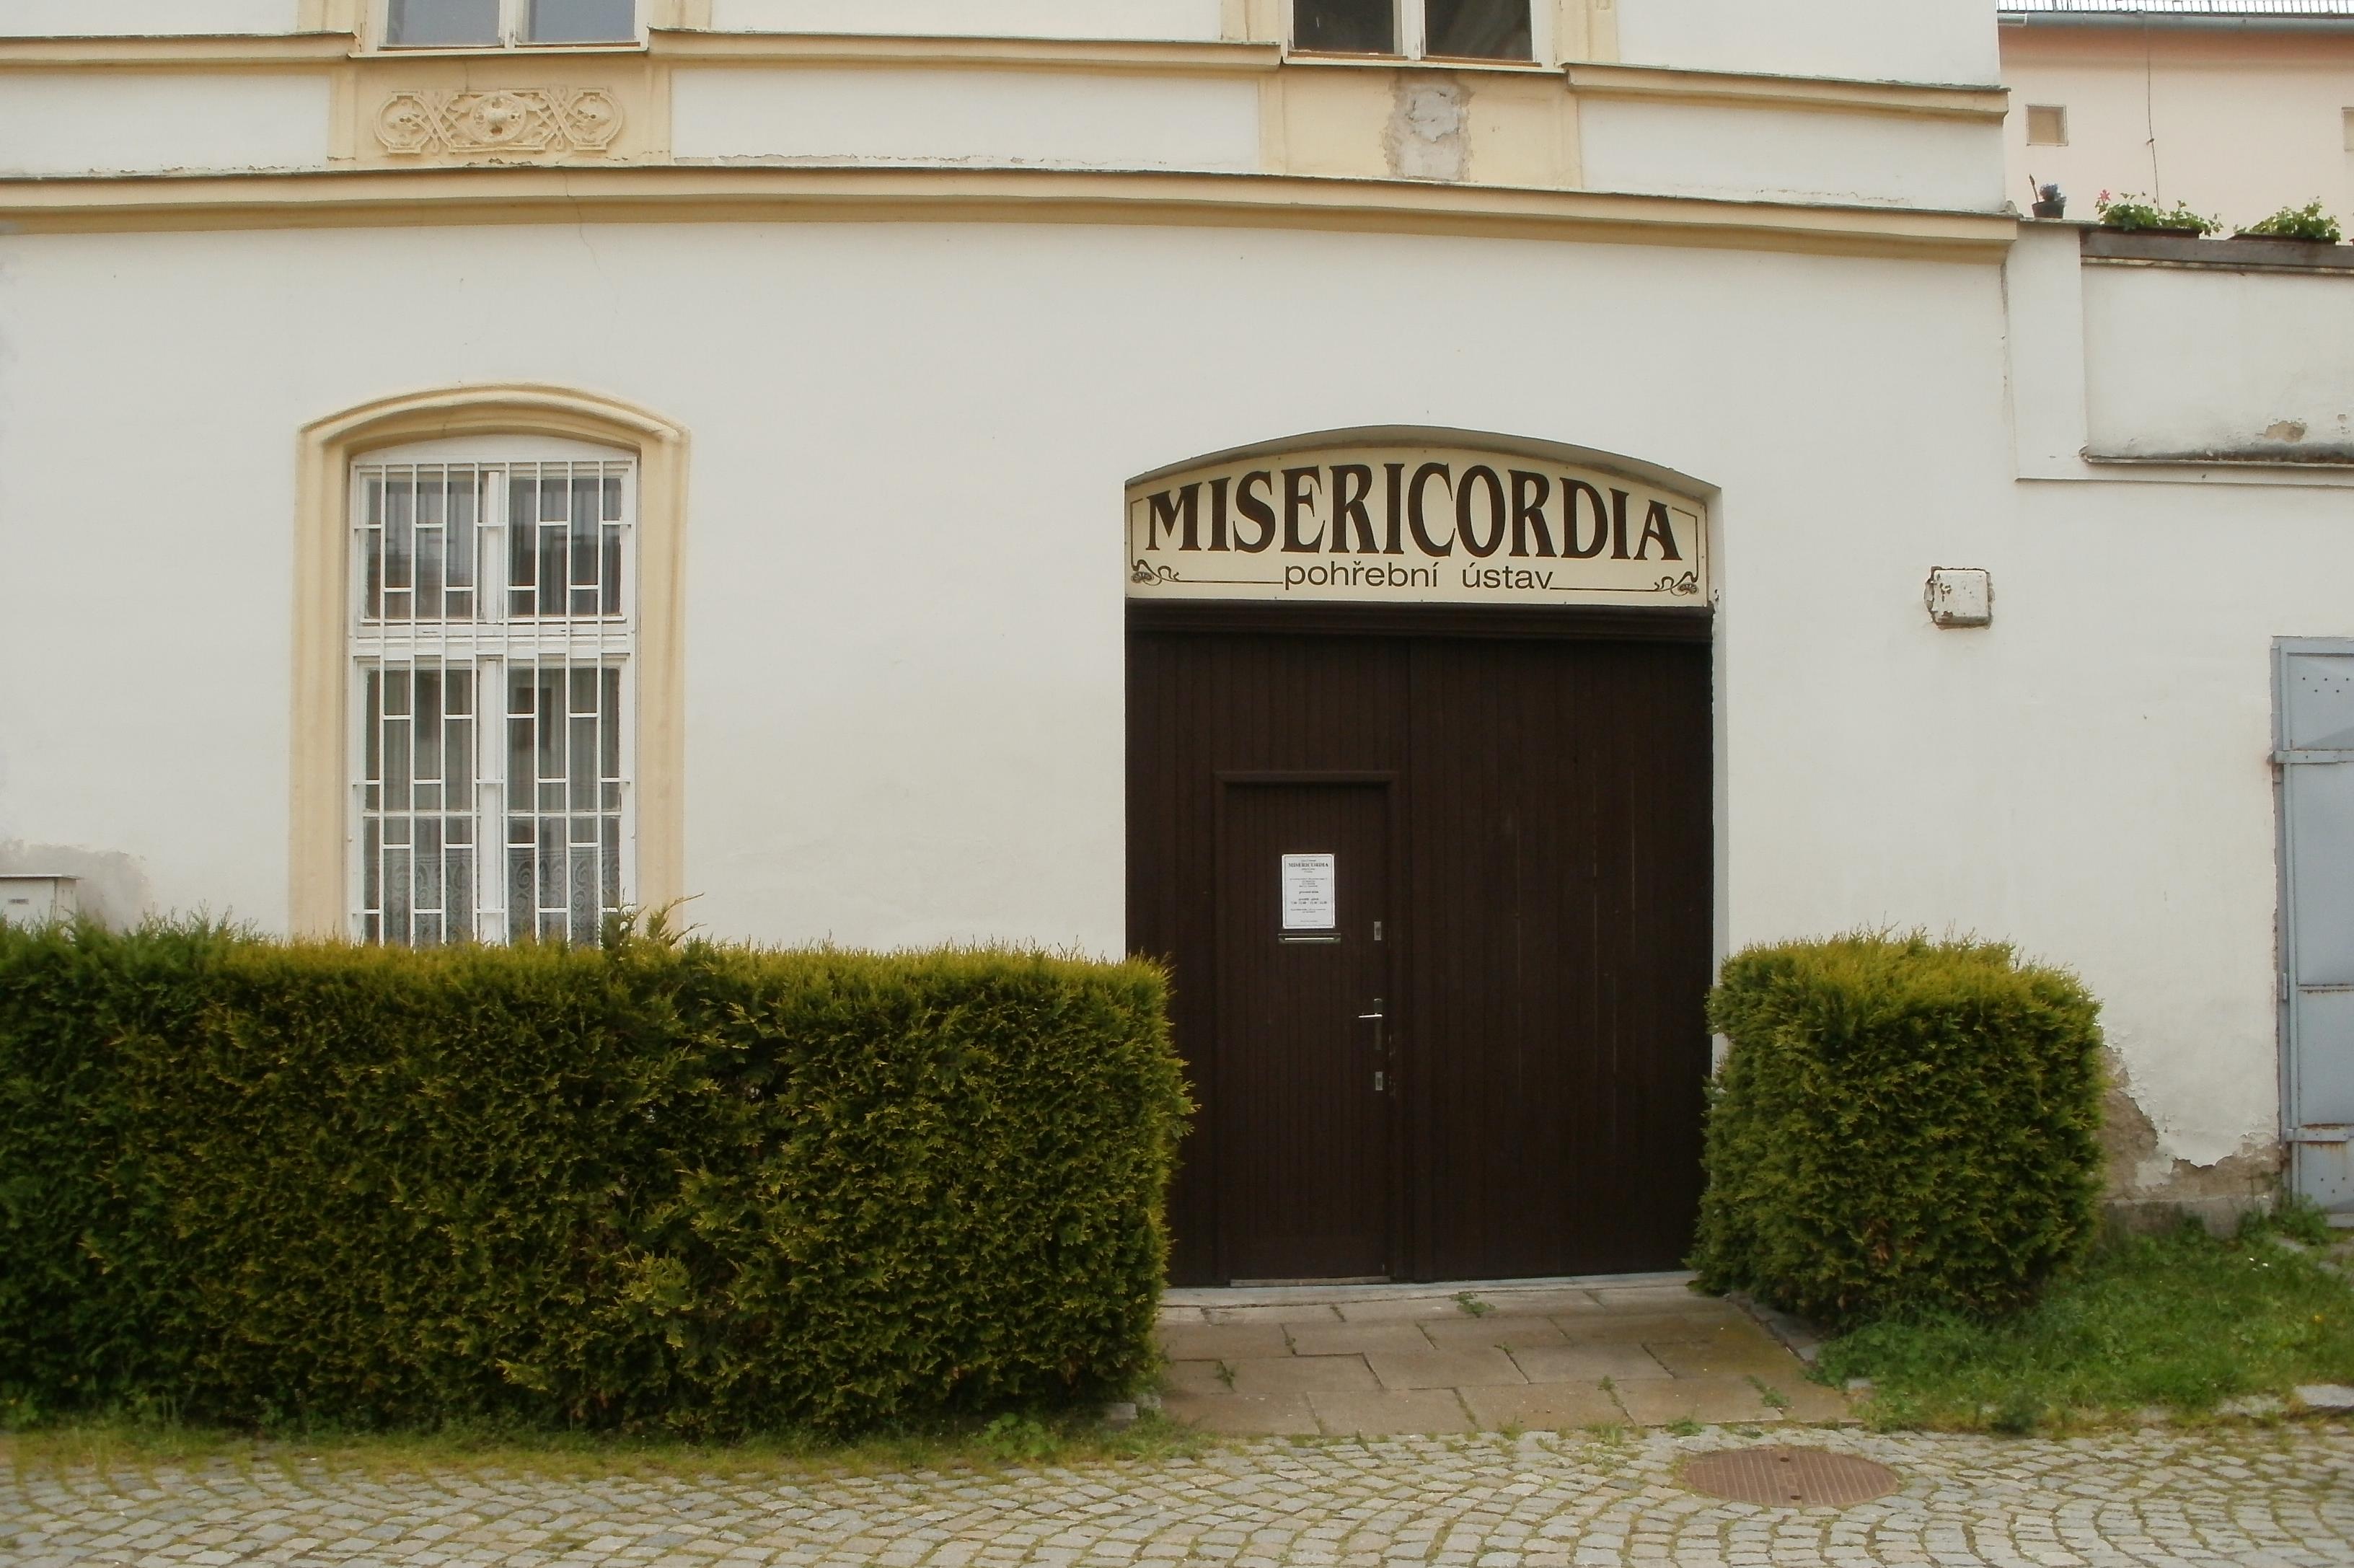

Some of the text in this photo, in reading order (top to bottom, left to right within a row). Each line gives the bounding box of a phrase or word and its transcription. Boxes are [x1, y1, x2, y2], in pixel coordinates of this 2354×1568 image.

[1145, 462, 1683, 561] MISERICORDIA
[1284, 560, 1553, 590] pohřební ústav
